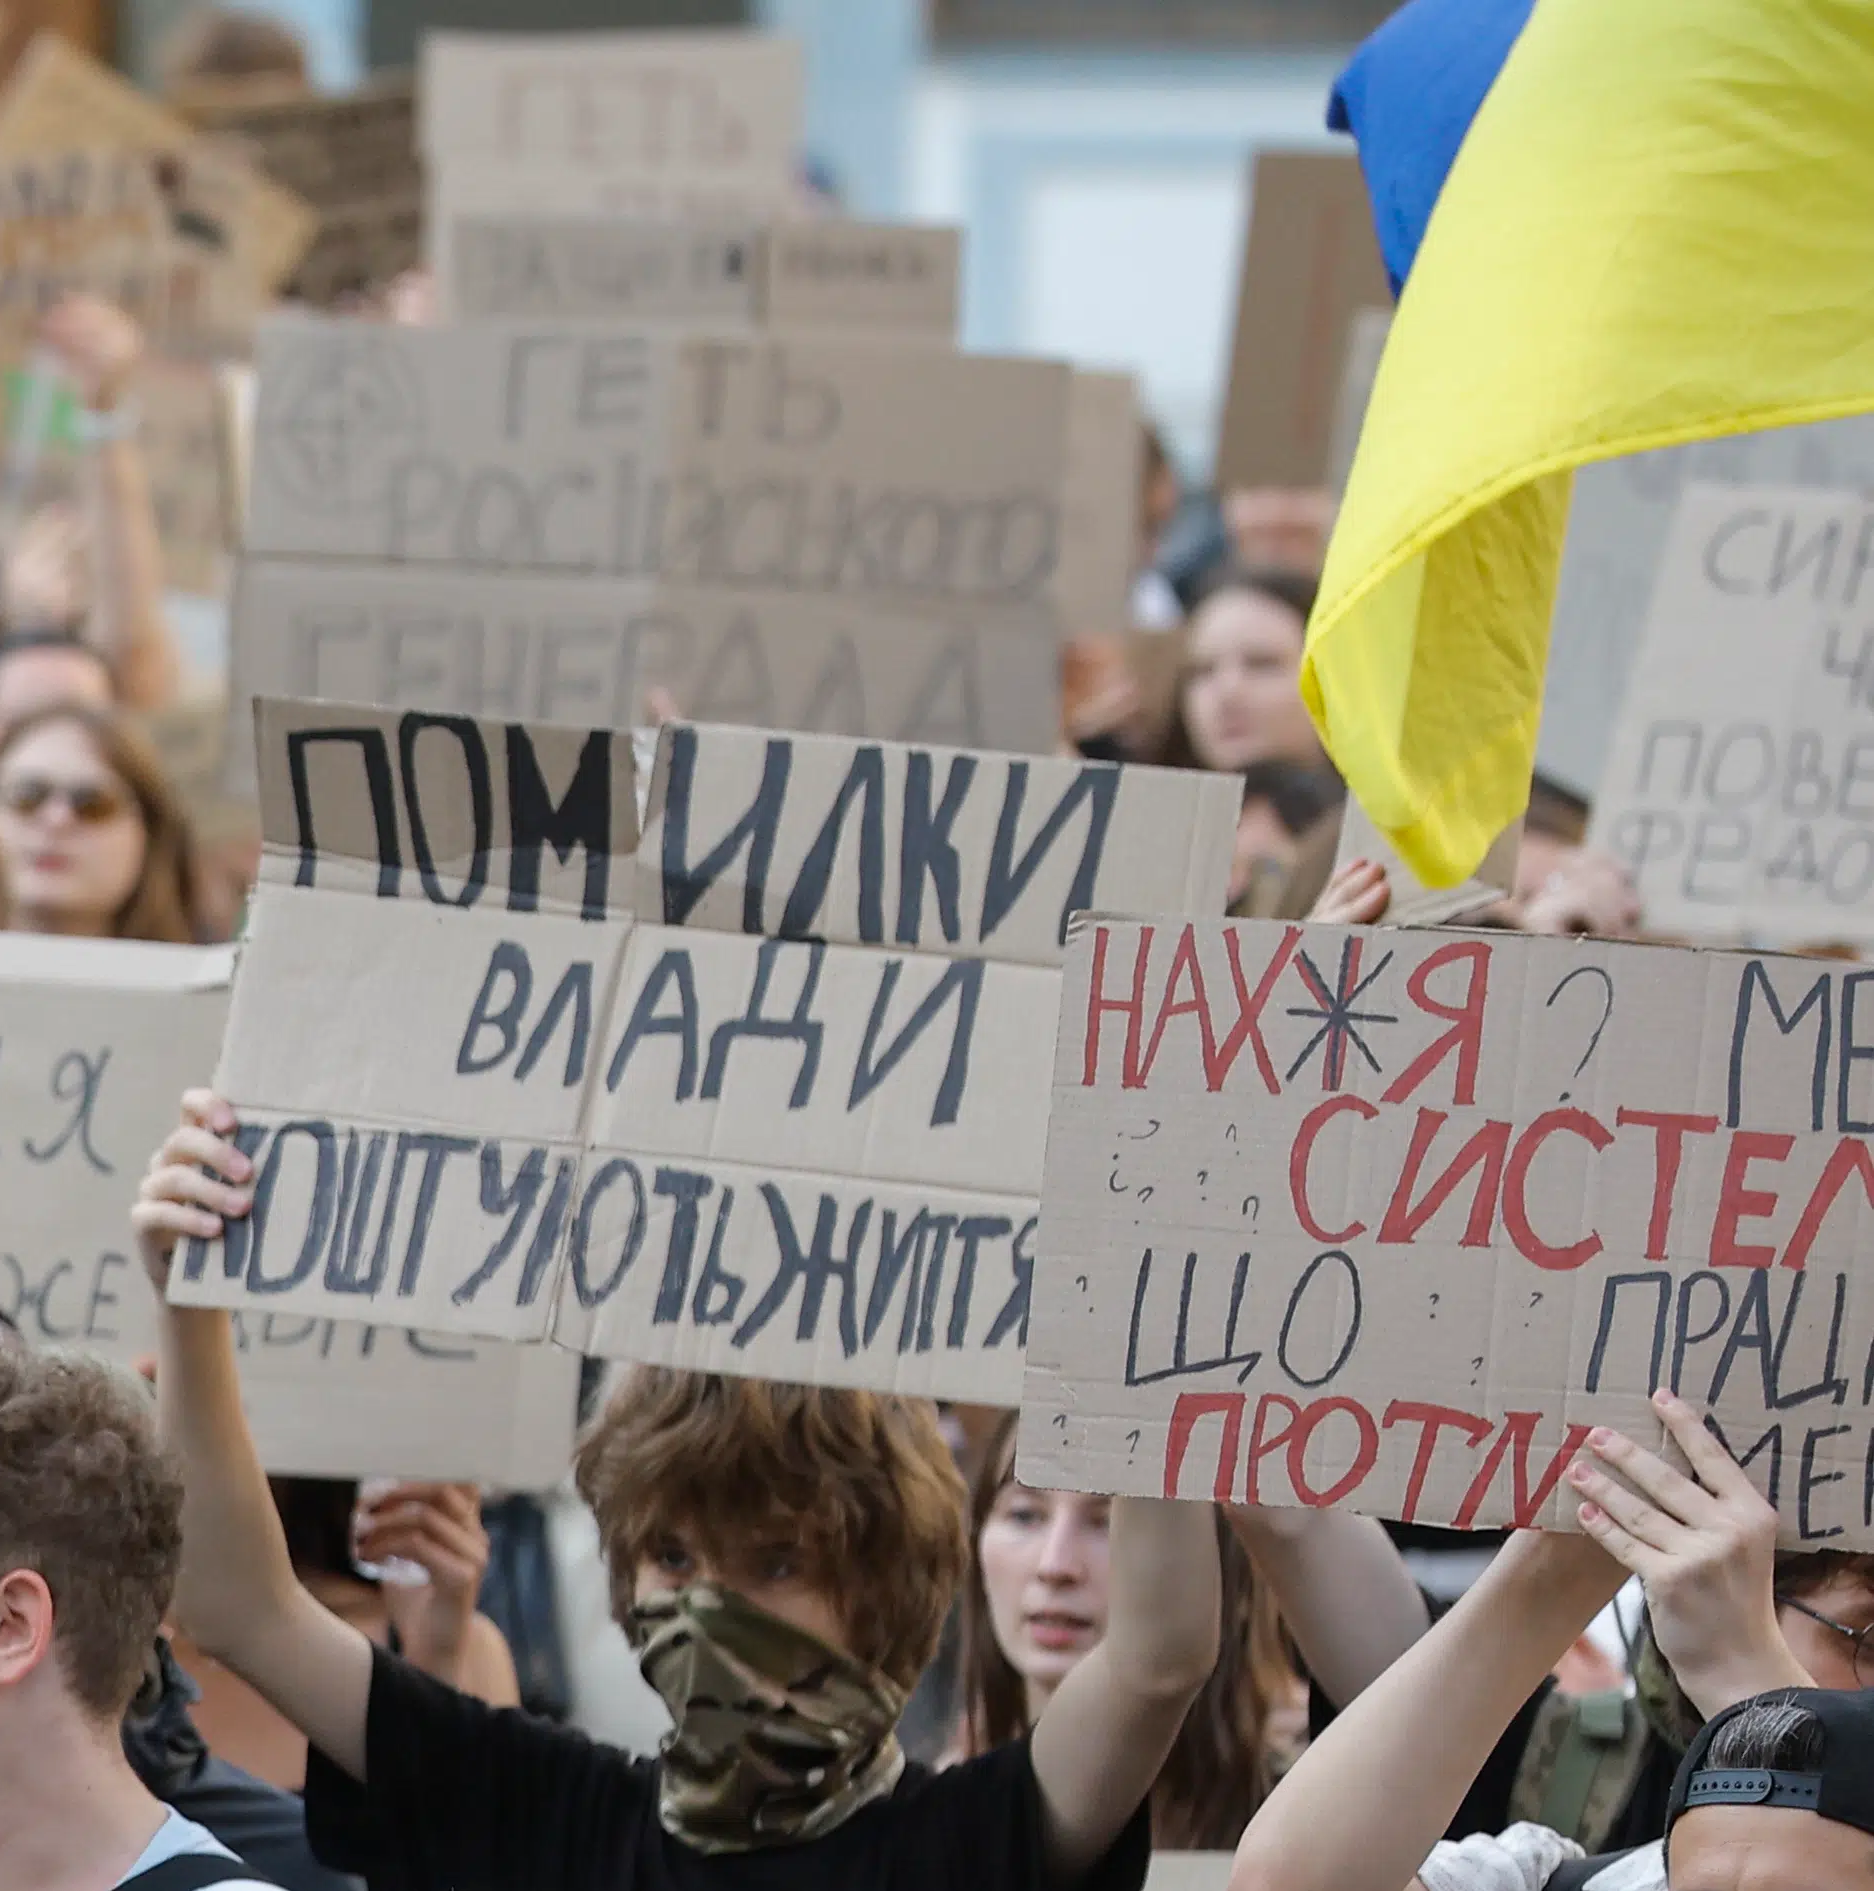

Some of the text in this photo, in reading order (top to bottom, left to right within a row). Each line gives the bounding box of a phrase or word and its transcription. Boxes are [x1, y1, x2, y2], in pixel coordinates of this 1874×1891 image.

[502, 333, 846, 445] ГЕТЬ
[285, 710, 1126, 947] ПОМИЛКИ
[454, 932, 987, 1130] ВЛАДИ
[1124, 1246, 1364, 1389] ЩО
[1585, 1266, 1874, 1414] ПРАЦ
[1163, 1390, 1594, 1532] ПРОТИ
